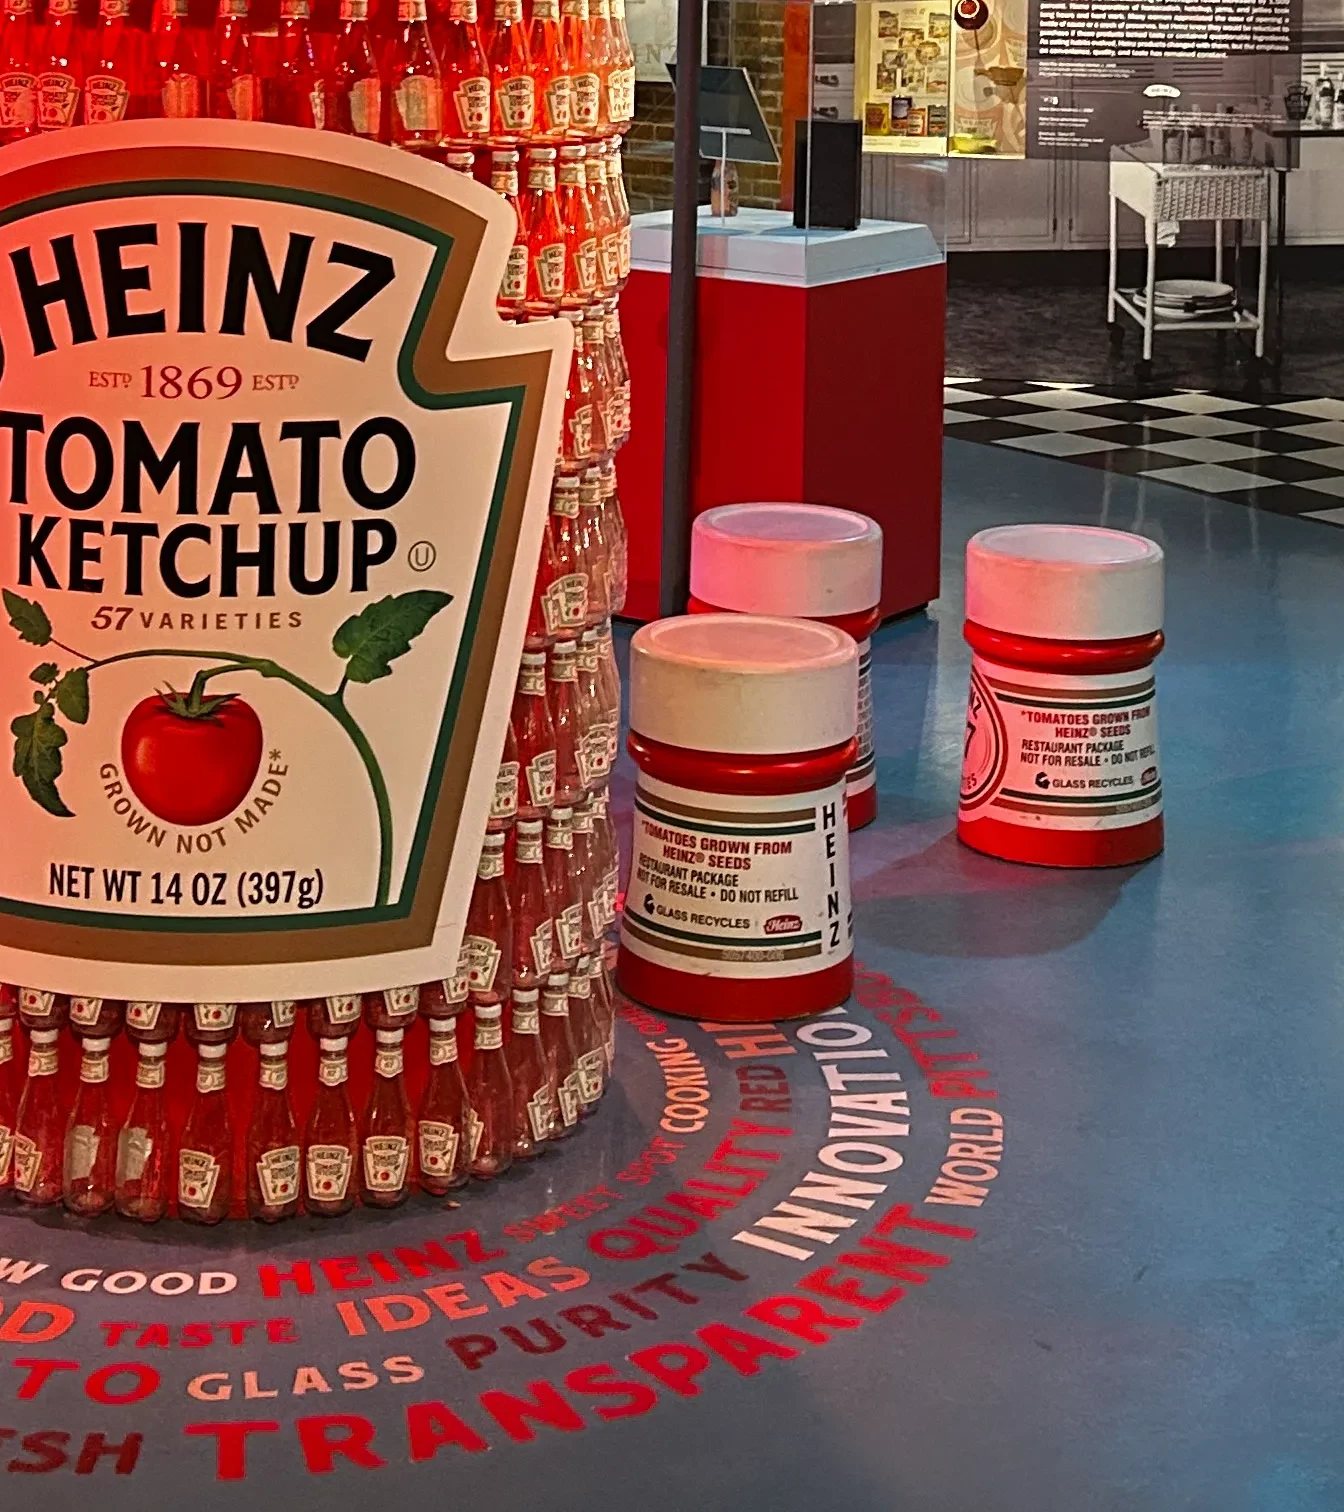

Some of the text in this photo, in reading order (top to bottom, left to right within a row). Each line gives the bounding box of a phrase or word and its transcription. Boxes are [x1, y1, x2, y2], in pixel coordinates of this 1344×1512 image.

[9, 222, 396, 363] HEINZ
[140, 365, 243, 400] 1869
[17, 513, 398, 599] KETCHUP
[90, 605, 304, 631] 57 VARIETIES
[1092, 711, 1129, 724] GROWN
[1100, 724, 1131, 738] SEEDS
[1020, 752, 1040, 764] NOT
[1042, 754, 1062, 766] FOR
[1064, 755, 1101, 767] RESALE
[1021, 739, 1083, 754] RESTAURANT
[1052, 778, 1086, 789] GLASS
[1088, 775, 1134, 789] RECYCLES
[99, 761, 165, 849] GROWN
[175, 827, 228, 855] NOT
[700, 837, 751, 855] GROWN
[754, 840, 792, 855] FROM
[708, 854, 752, 870] SEEDS
[48, 863, 325, 911] NET WT 14 OZ (397g)
[638, 852, 739, 887] RESTAURANT PACKAGE
[650, 874, 667, 890] FOR
[668, 879, 707, 900] RESALE
[720, 888, 737, 903] DO
[740, 890, 762, 904] NOT
[764, 887, 799, 904] REFILL
[821, 801, 841, 950] HEINZ
[656, 905, 751, 929] GLASS RECYCLES
[765, 917, 801, 933] Heinz
[646, 1038, 711, 1134] COOKING
[735, 1063, 793, 1112] RED
[732, 1006, 911, 1261] INNOVATIO
[924, 1107, 1004, 1207] WORLD
[586, 1118, 794, 1263] QUALITY
[60, 1269, 238, 1296] GOOD
[259, 1229, 508, 1299] HEINZ
[336, 1256, 592, 1338] IDEAS
[443, 1250, 750, 1370] PURITY
[99, 1317, 301, 1349] TASTE
[185, 1202, 977, 1482] TRANSPARENT
[187, 1355, 426, 1401] GLASS
